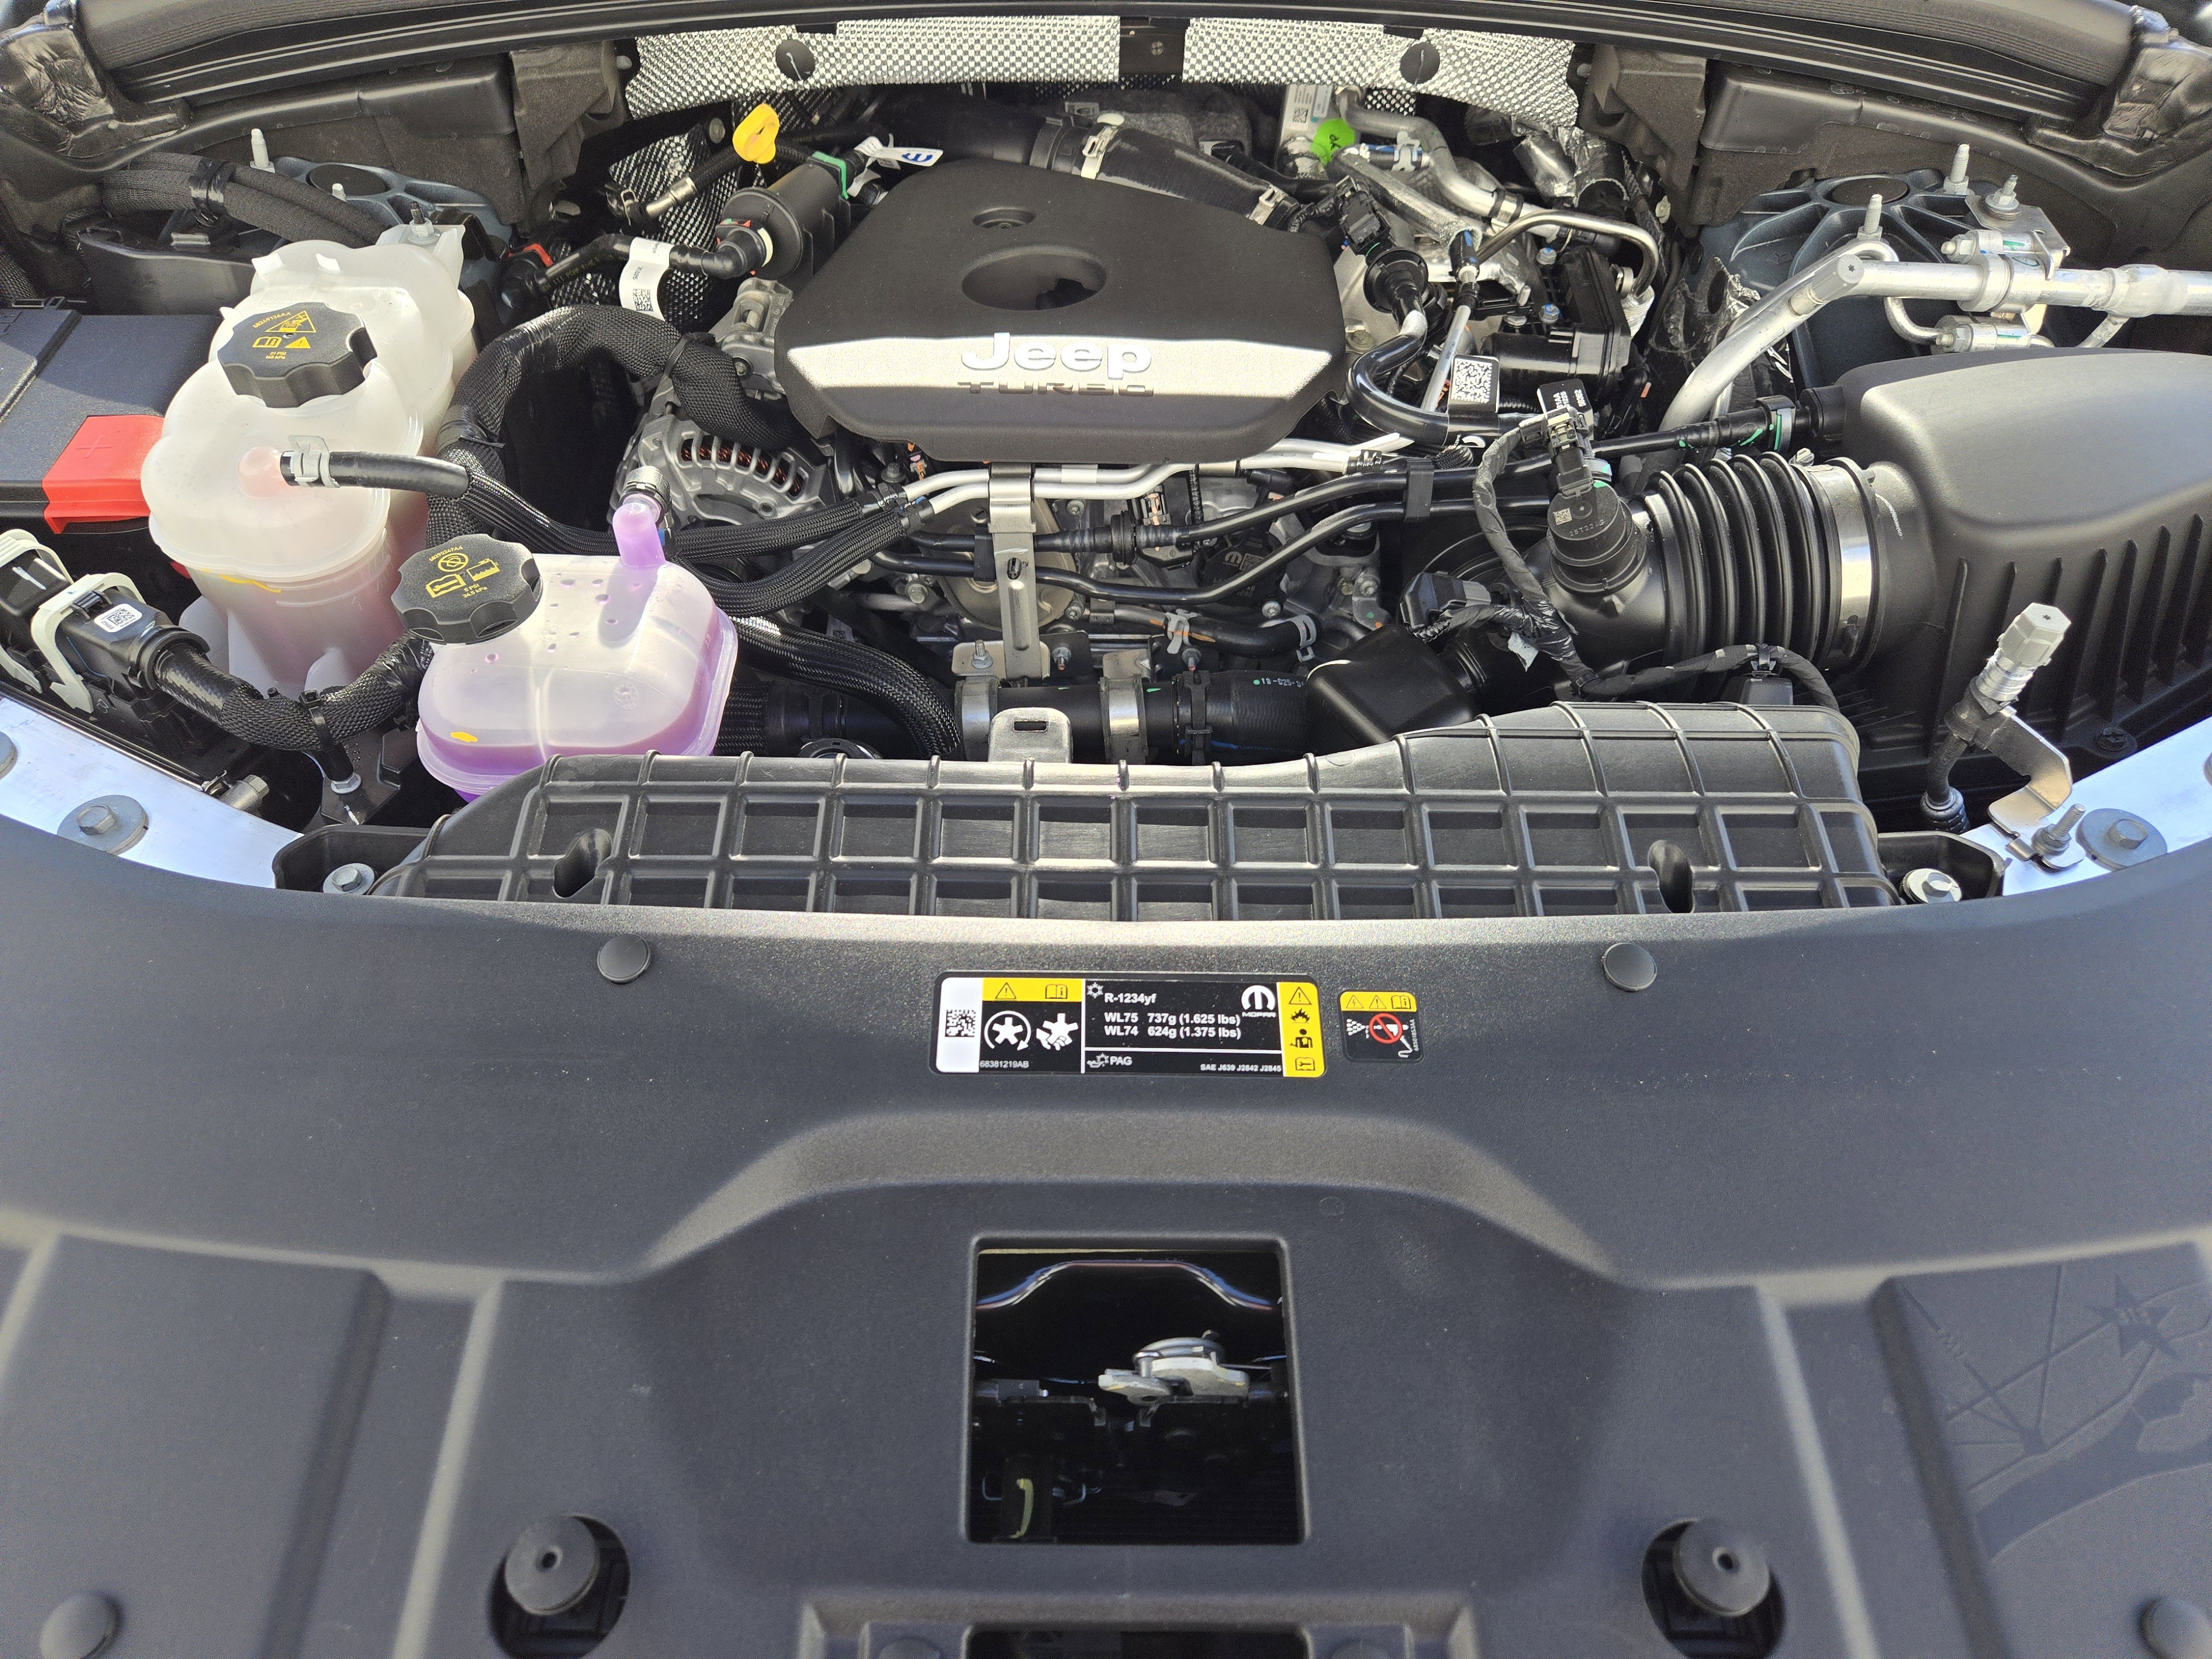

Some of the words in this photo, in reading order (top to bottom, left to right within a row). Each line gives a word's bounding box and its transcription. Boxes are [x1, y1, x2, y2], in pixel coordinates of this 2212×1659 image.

[961, 332, 1152, 380] Jeep
[957, 380, 1154, 397] TURBO
[429, 545, 464, 562] 68290247AA
[1104, 992, 1157, 1006] R-1234yf
[1104, 1011, 1139, 1023] WL75
[1147, 1013, 1177, 1026] 737g
[1179, 1013, 1215, 1026] (1.625
[1218, 1014, 1241, 1027] lbs)
[1104, 1025, 1139, 1036] WL74
[1147, 1026, 1177, 1039] 624g
[1179, 1026, 1216, 1039] (1.375
[1218, 1026, 1241, 1040] lbs)
[1110, 1056, 1133, 1066] PAG
[1237, 1064, 1259, 1072] J2842
